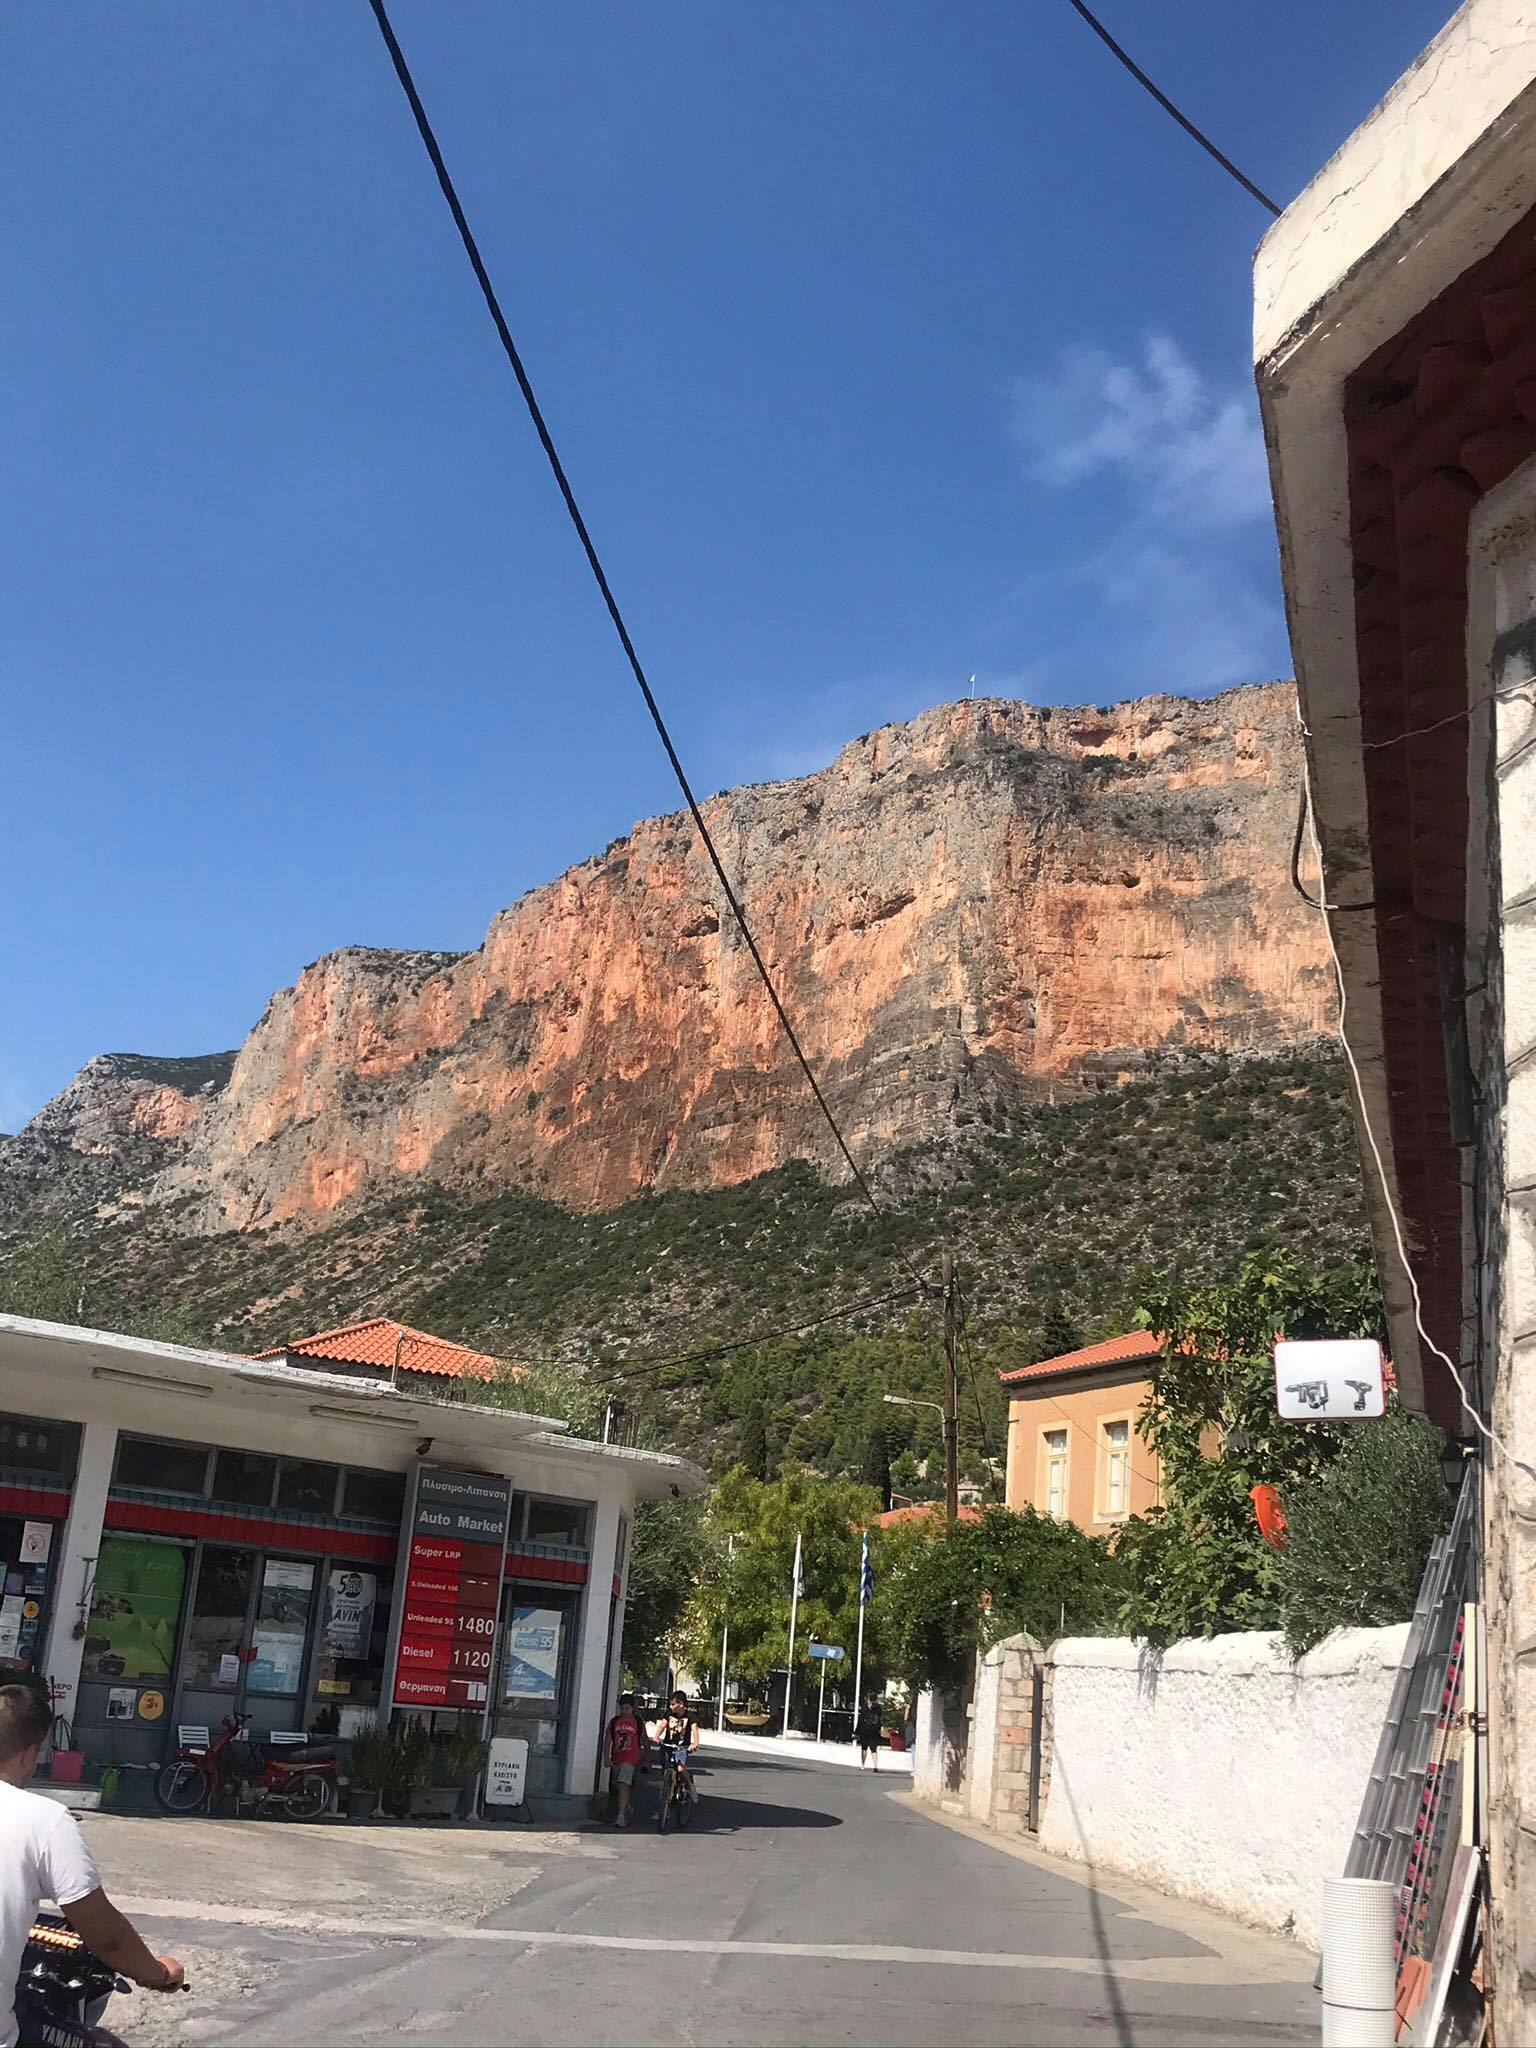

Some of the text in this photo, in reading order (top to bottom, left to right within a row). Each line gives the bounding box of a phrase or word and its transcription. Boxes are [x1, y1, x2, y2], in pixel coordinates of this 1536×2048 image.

[419, 1510, 504, 1534] Auto Market
[414, 1545, 461, 1560] Super LRP
[447, 1585, 459, 1593] 100
[333, 1608, 362, 1623] AVIN
[407, 1612, 495, 1636] Unleaded 95 1480
[539, 1636, 554, 1648] 95
[402, 1645, 491, 1669] Diesel 1120
[399, 1680, 446, 1696] Θερμανση
[42, 2024, 84, 2048] YAMAHA
